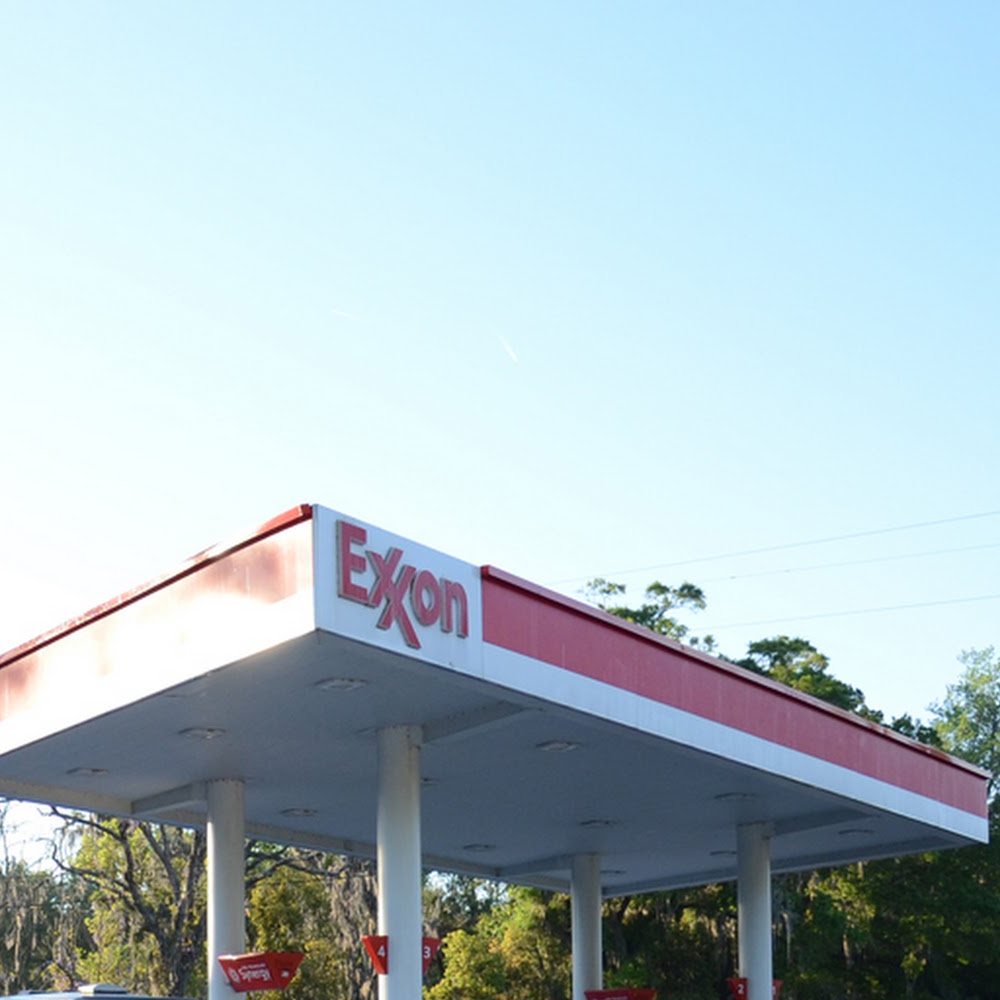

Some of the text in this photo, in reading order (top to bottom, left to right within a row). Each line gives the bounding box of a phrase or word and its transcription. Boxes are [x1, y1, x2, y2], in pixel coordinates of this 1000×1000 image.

[336, 519, 469, 650] Exxon
[377, 945, 386, 957] 4
[423, 946, 431, 959] 3
[737, 983, 745, 995] 2
